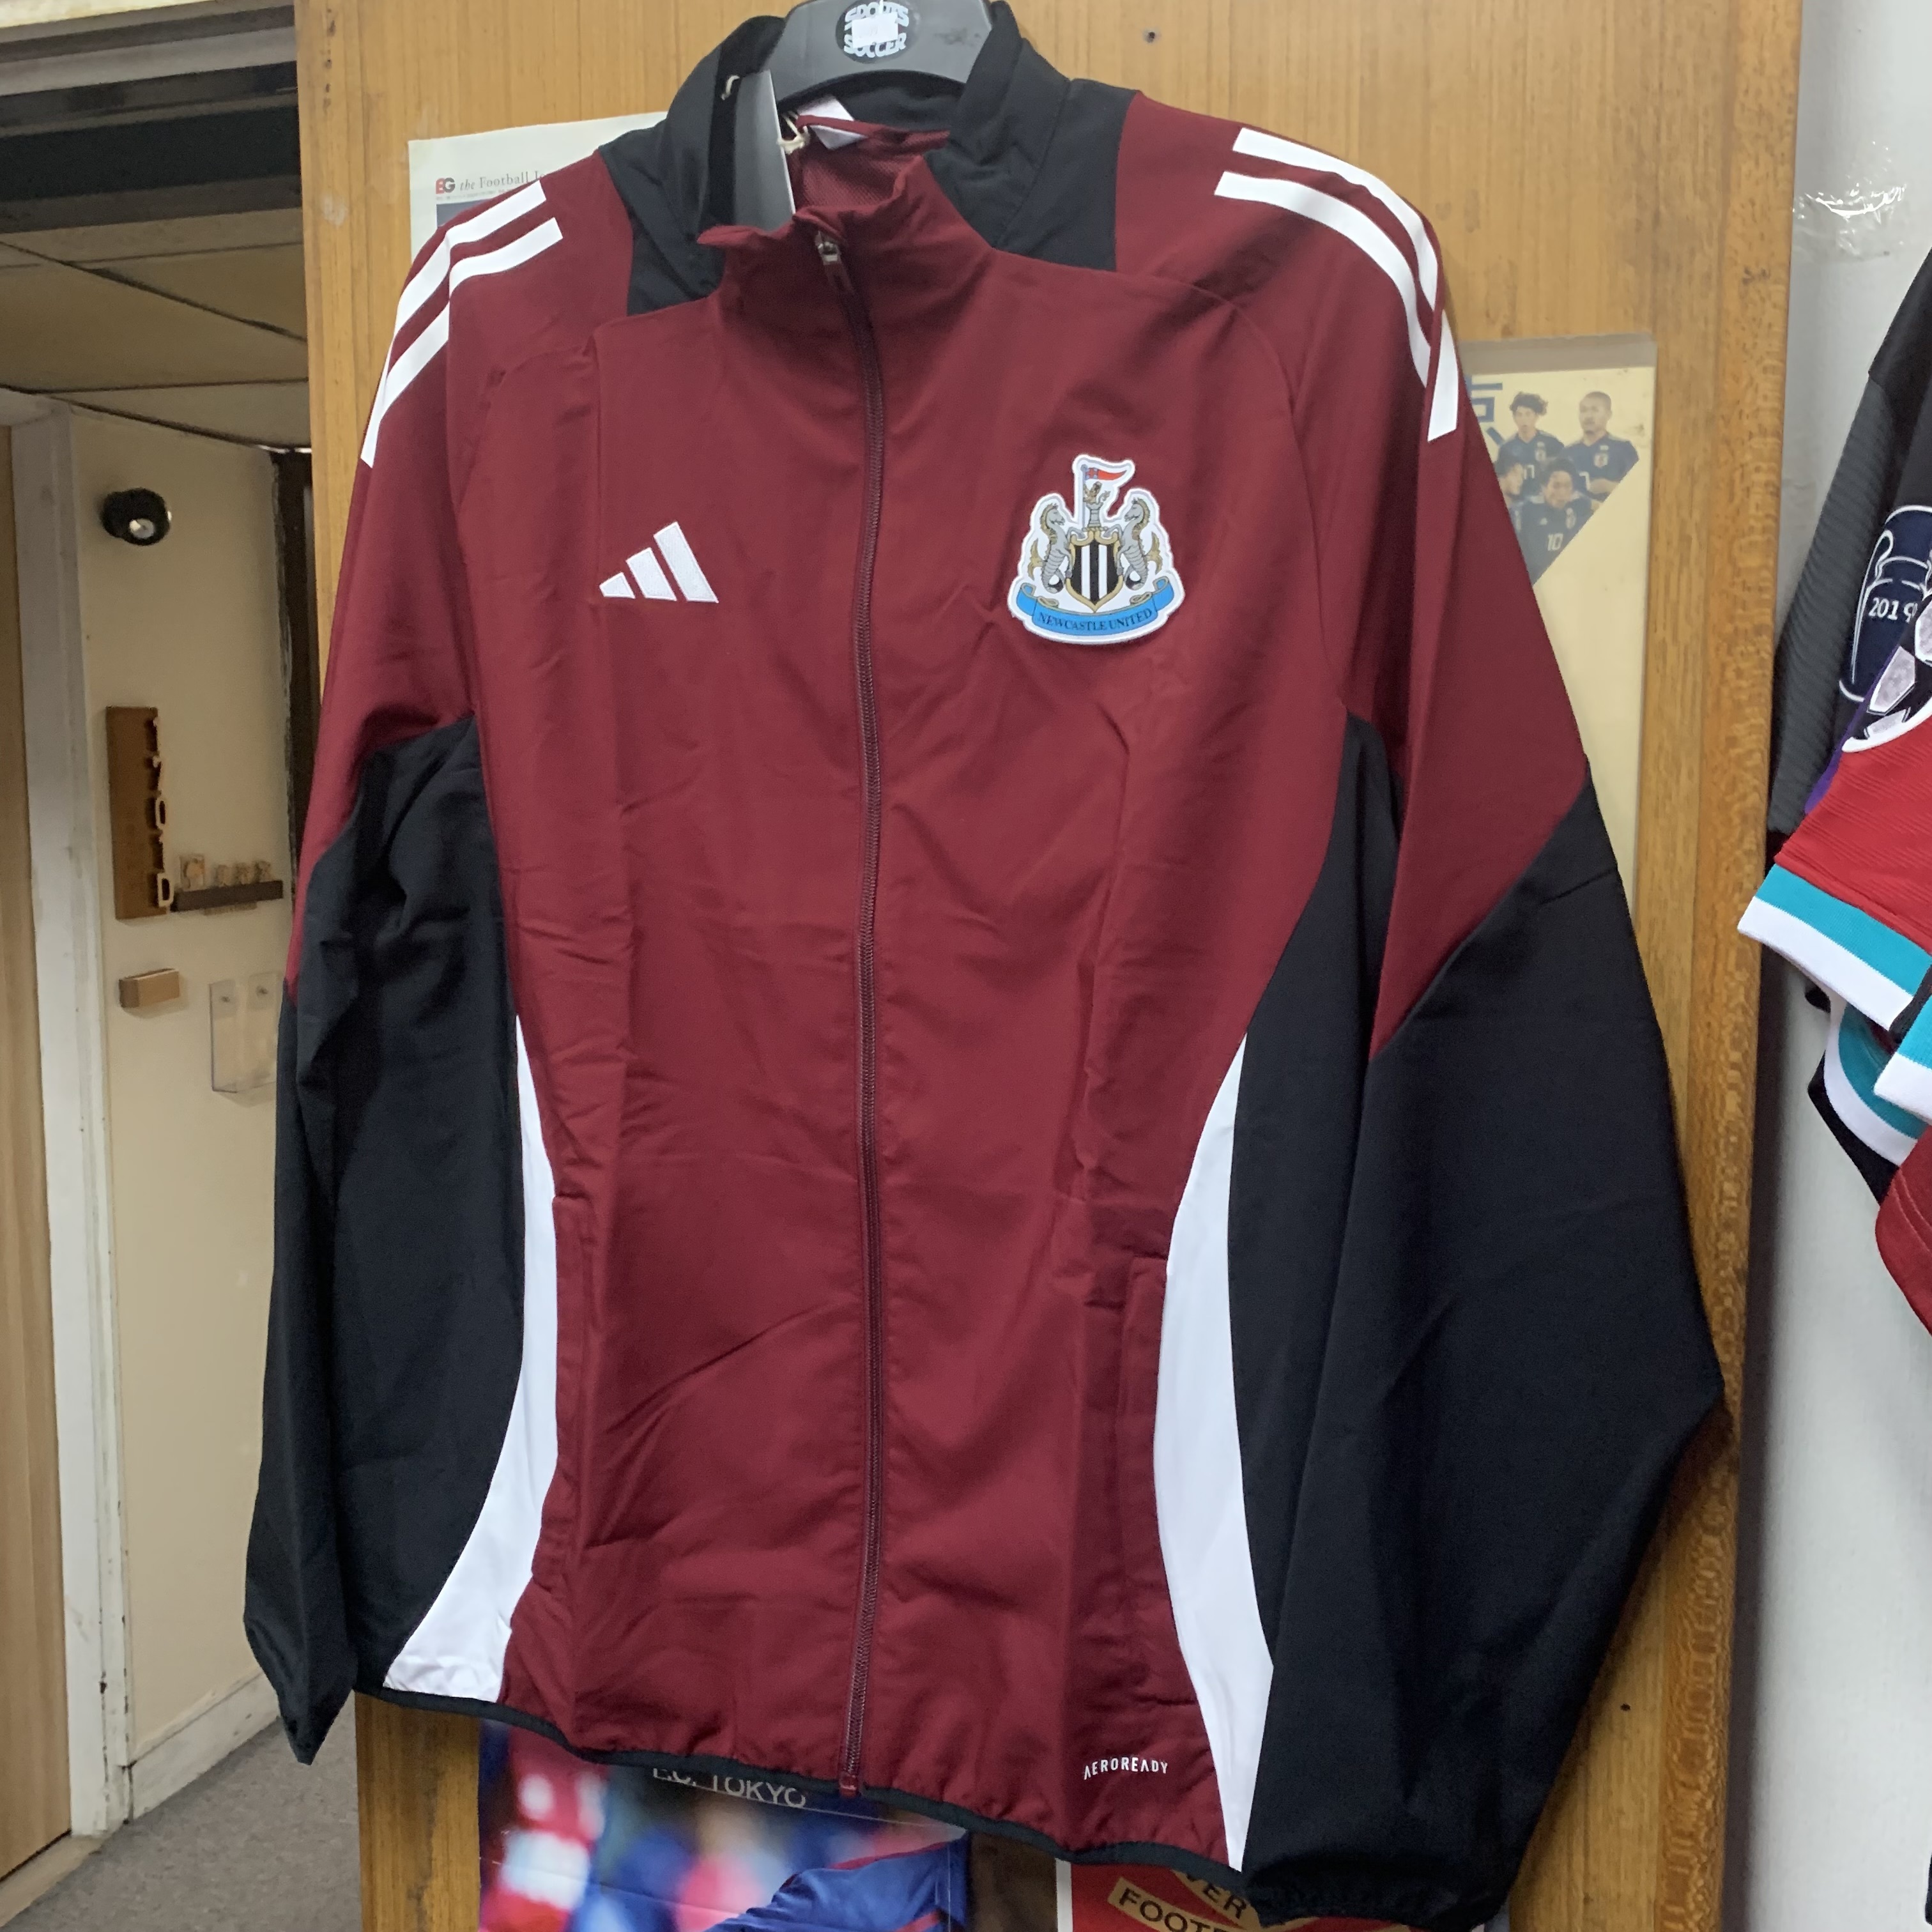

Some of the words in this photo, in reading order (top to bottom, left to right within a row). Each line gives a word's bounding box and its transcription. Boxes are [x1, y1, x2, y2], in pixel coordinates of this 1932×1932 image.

[844, 33, 907, 57] SOCCER
[460, 179, 475, 191] the
[480, 171, 528, 188] Football
[1547, 533, 1563, 551] 10
[1039, 611, 1107, 631] NEWCASTLE
[1109, 608, 1152, 630] UNITED
[1084, 1757, 1168, 1780] AEROREADY
[1119, 1887, 1229, 1932] FOOT
